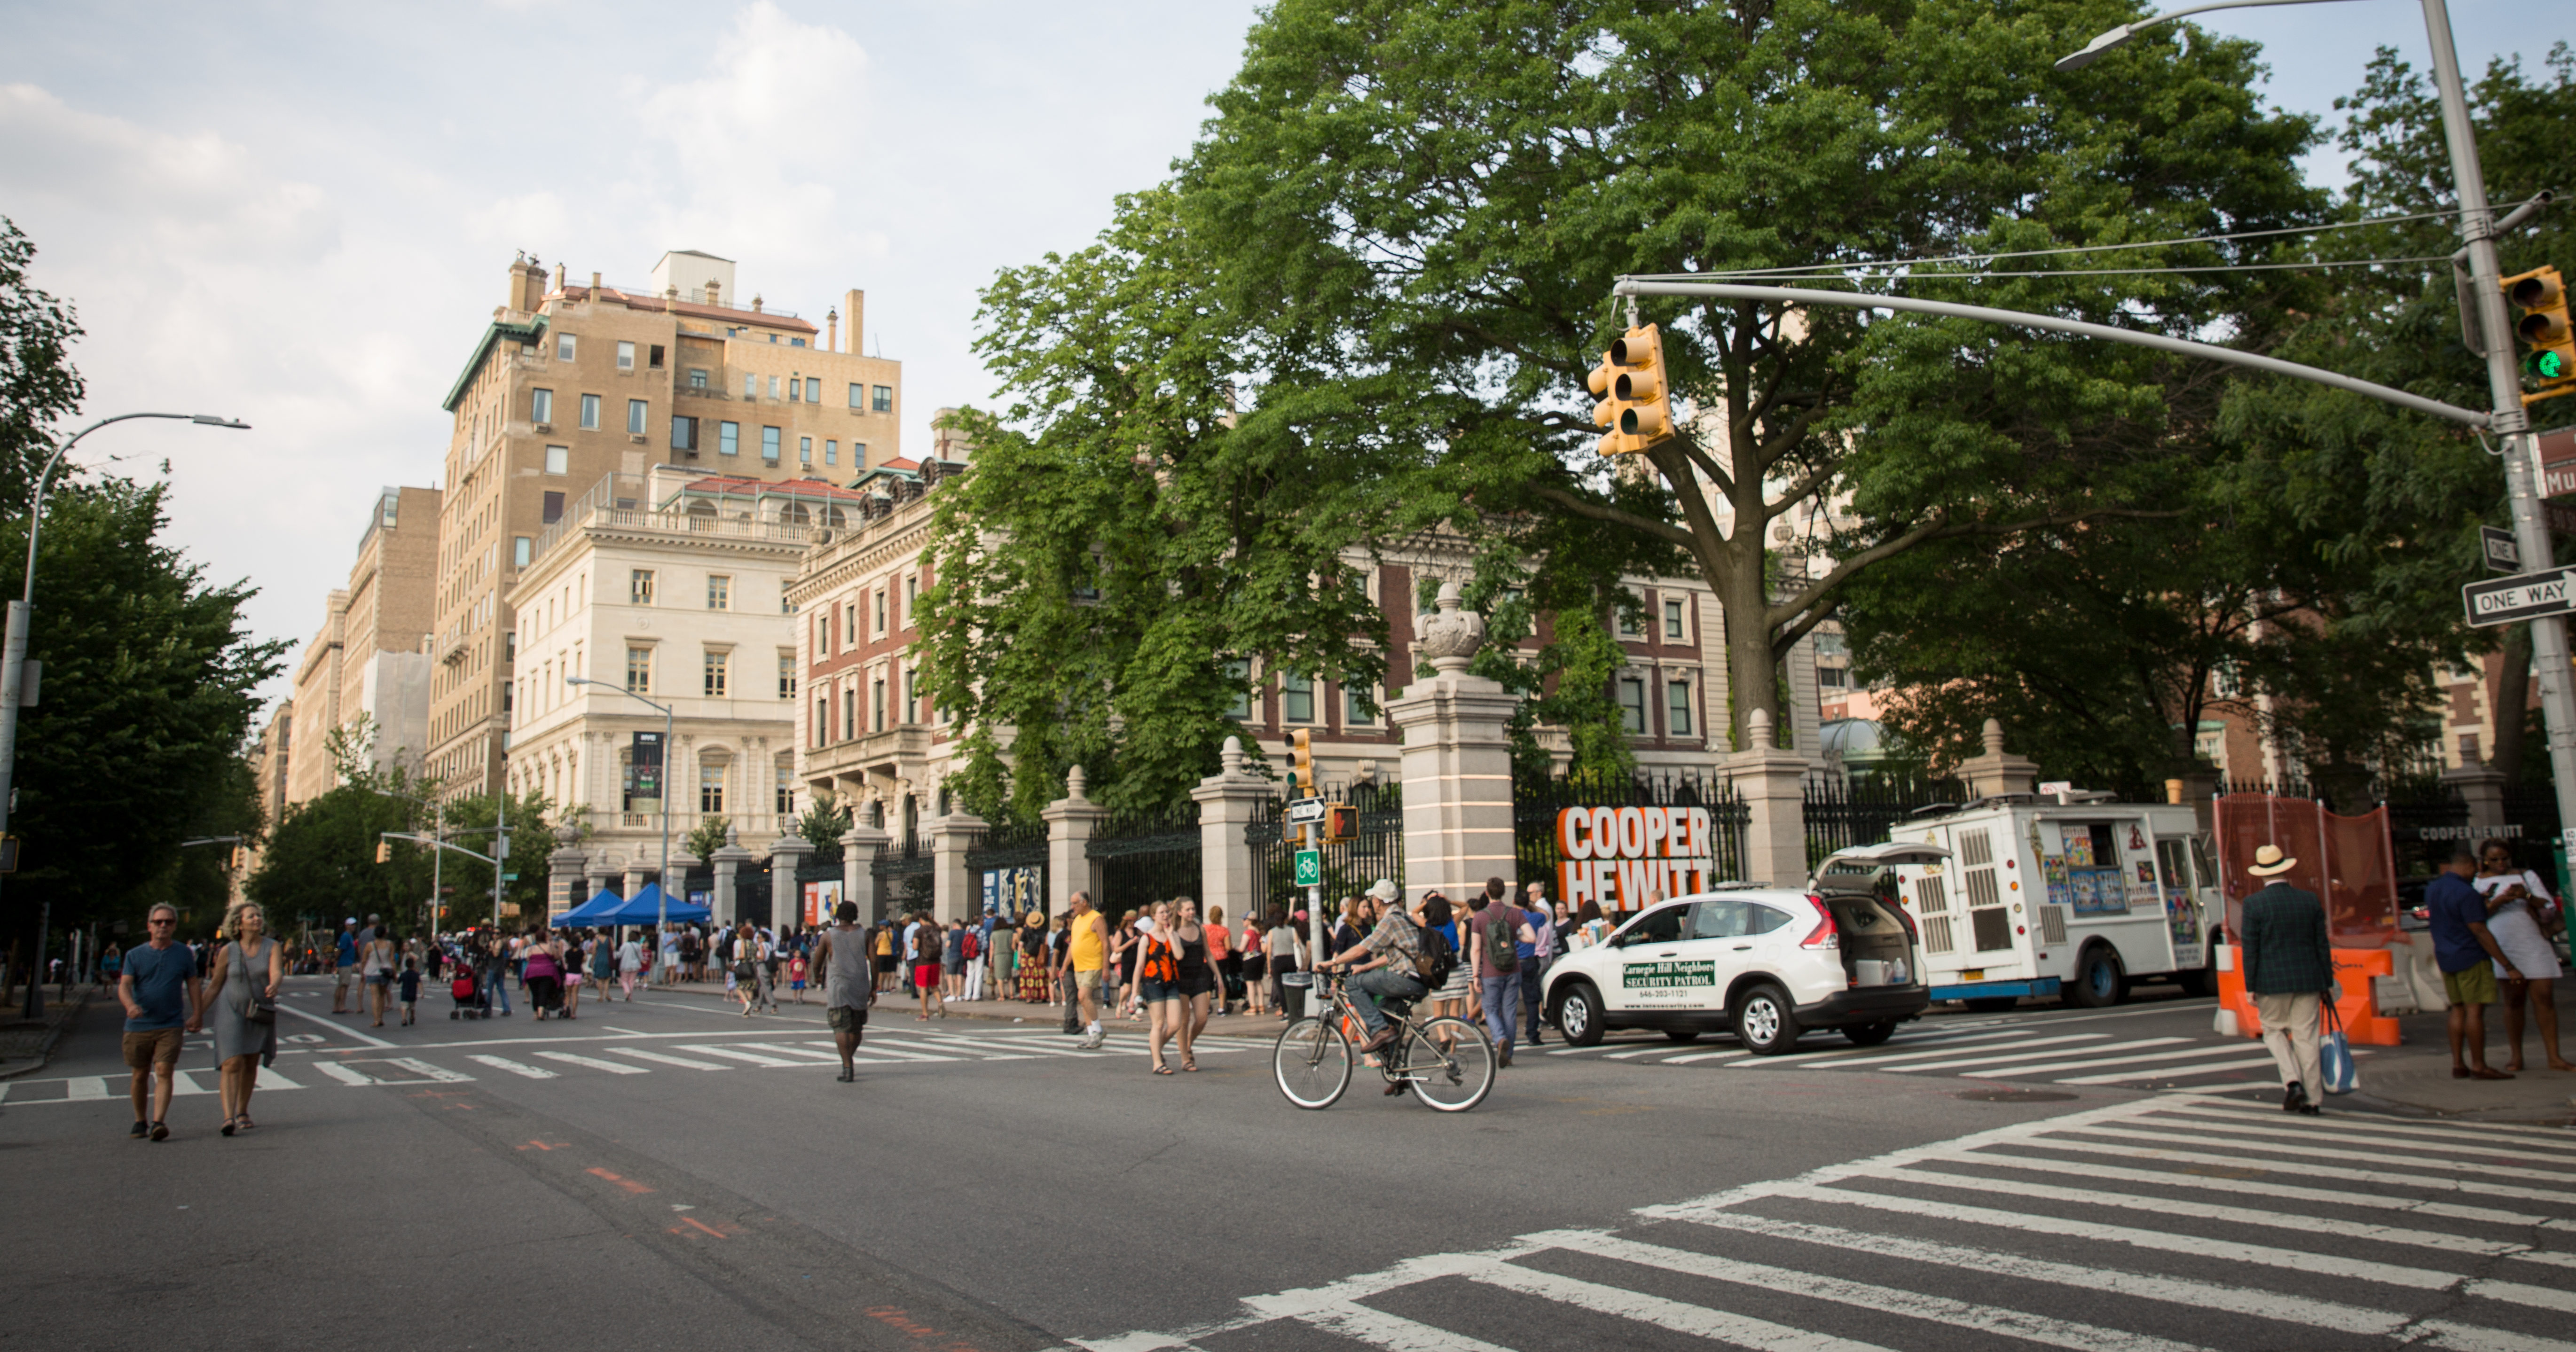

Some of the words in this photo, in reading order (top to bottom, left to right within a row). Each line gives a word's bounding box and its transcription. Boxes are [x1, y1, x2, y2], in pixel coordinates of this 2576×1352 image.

[2481, 591, 2518, 610] ONE
[2527, 581, 2566, 602] WAY
[1557, 806, 1712, 859] COOPER
[1558, 859, 1713, 913] HEWITT
[1623, 963, 1656, 977] Carnegie
[1657, 962, 1673, 973] Hill
[1674, 961, 1714, 975] Neighbors
[1626, 977, 1672, 987] SECURITY
[1674, 975, 1712, 986] PATROL
